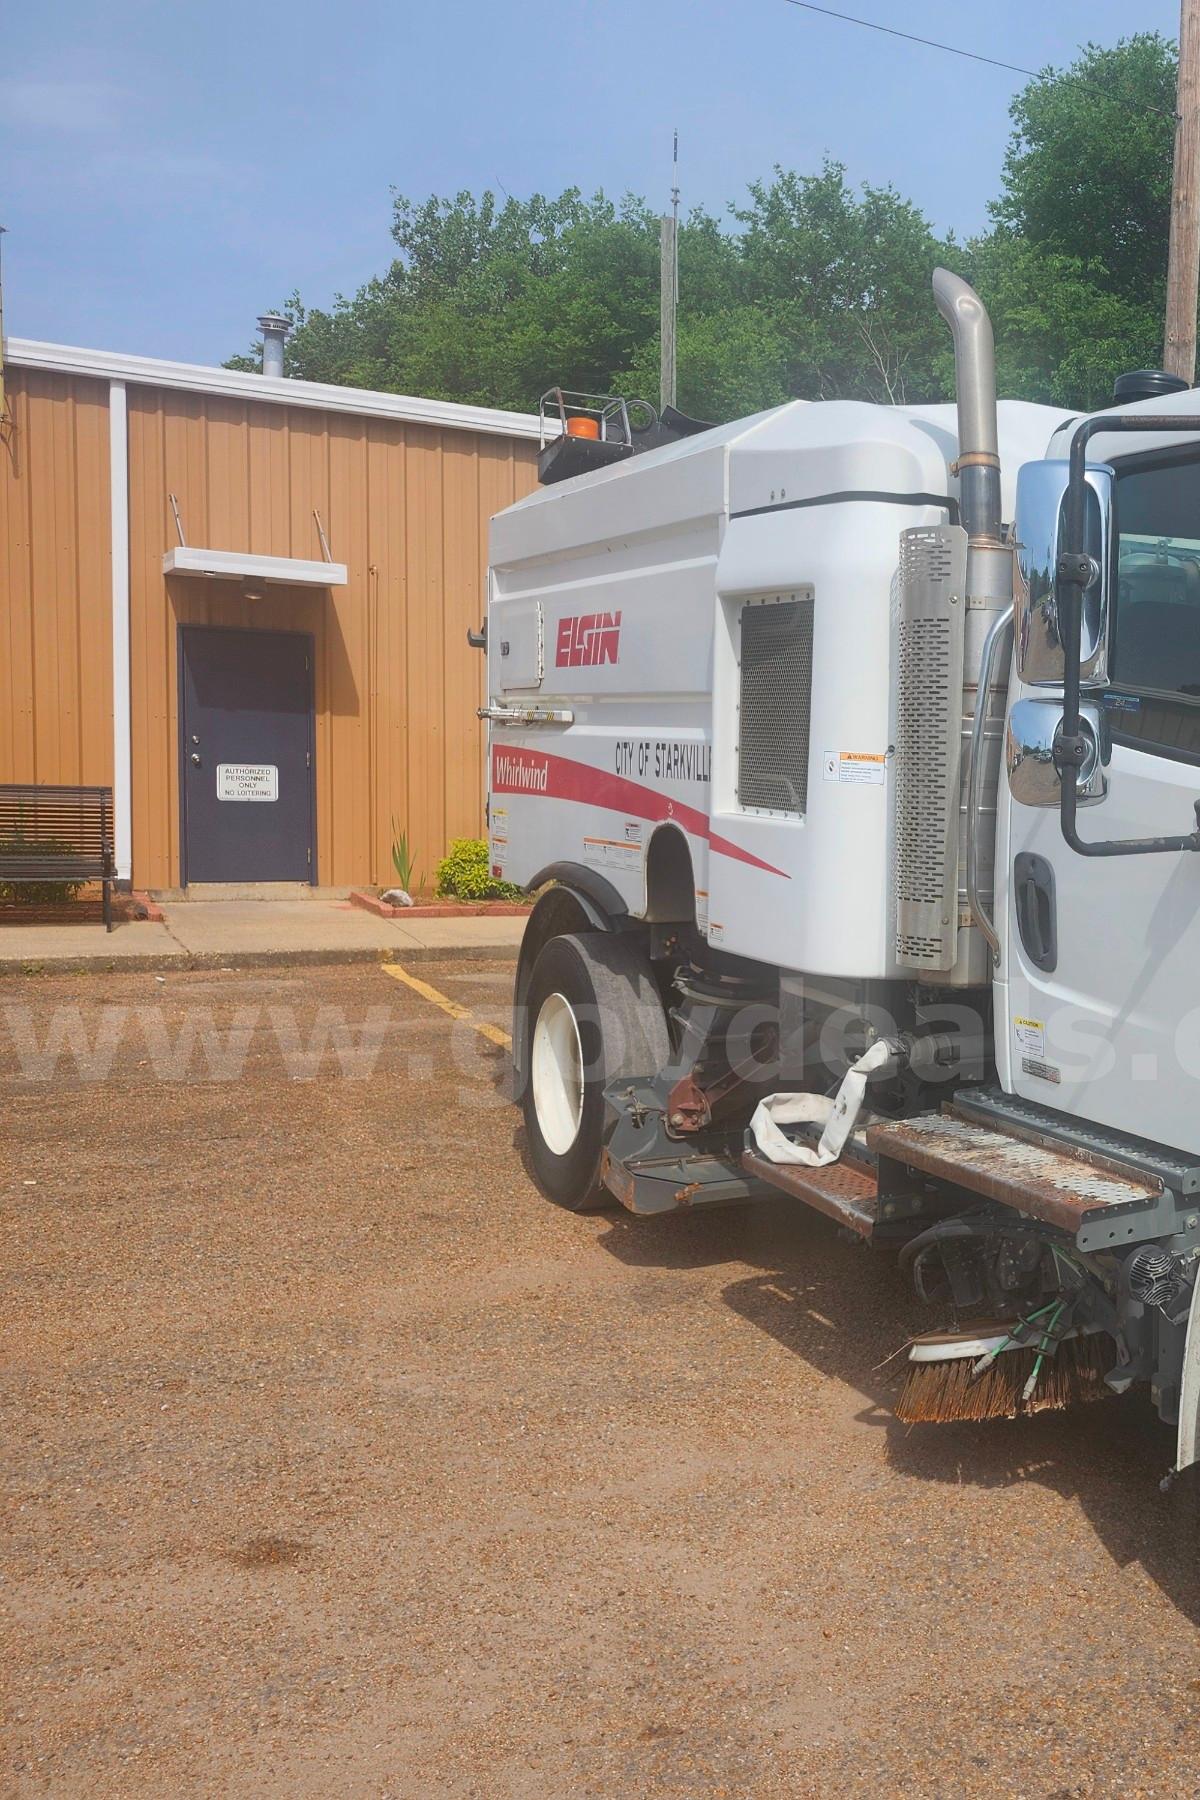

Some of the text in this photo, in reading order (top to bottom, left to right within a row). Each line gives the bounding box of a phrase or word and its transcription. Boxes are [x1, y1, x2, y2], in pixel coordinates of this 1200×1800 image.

[555, 610, 622, 668] ELGIN
[496, 755, 549, 792] Whirlwind
[616, 742, 634, 776] CITY
[638, 742, 651, 777] OF
